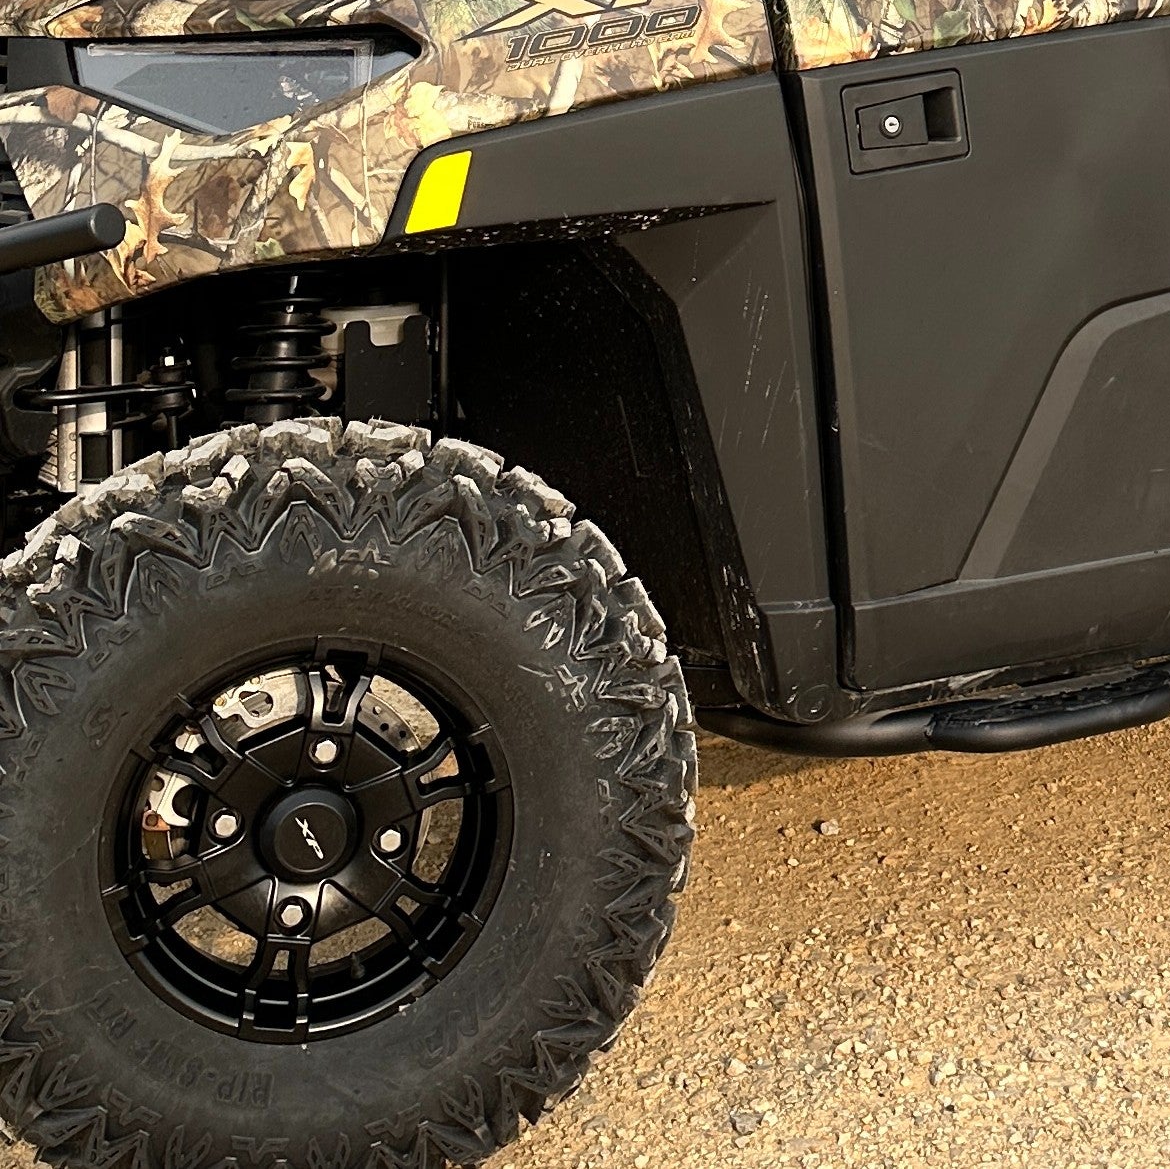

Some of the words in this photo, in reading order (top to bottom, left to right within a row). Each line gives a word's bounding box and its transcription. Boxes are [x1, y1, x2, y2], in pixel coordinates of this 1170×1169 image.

[506, 4, 702, 63] 1000
[506, 56, 556, 72] DUAL
[294, 817, 324, 860] XP
